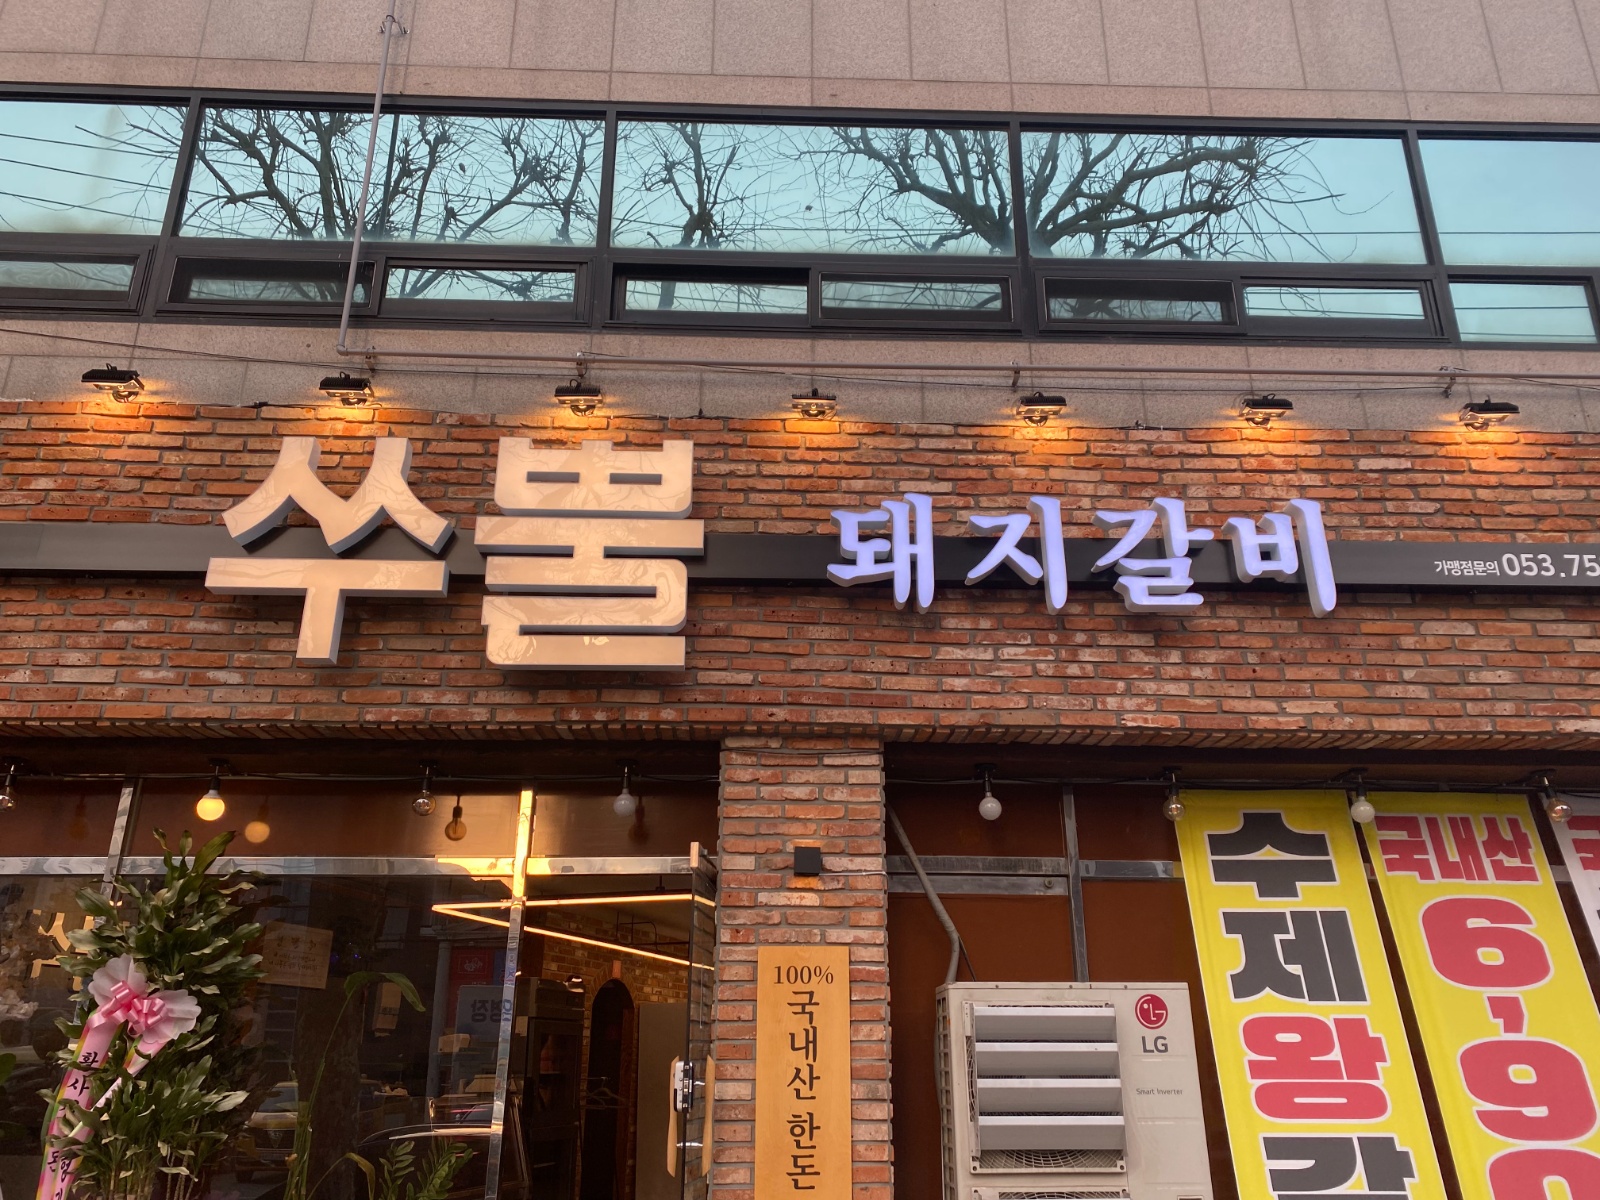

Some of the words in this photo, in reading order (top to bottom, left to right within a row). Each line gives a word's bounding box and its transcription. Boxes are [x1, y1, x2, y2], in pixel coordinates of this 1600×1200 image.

[826, 492, 1338, 618] 돼지갈비
[1434, 559, 1500, 577] 가맹점문의
[1501, 552, 1600, 578] 053.75
[1374, 814, 1541, 882] 국내산
[773, 965, 834, 985] 100%
[786, 990, 821, 1100] 국내산
[1141, 1035, 1169, 1054] LG
[1135, 1087, 1155, 1097] Smart
[1156, 1087, 1184, 1097] Inverter
[785, 1111, 821, 1190] 한돈
